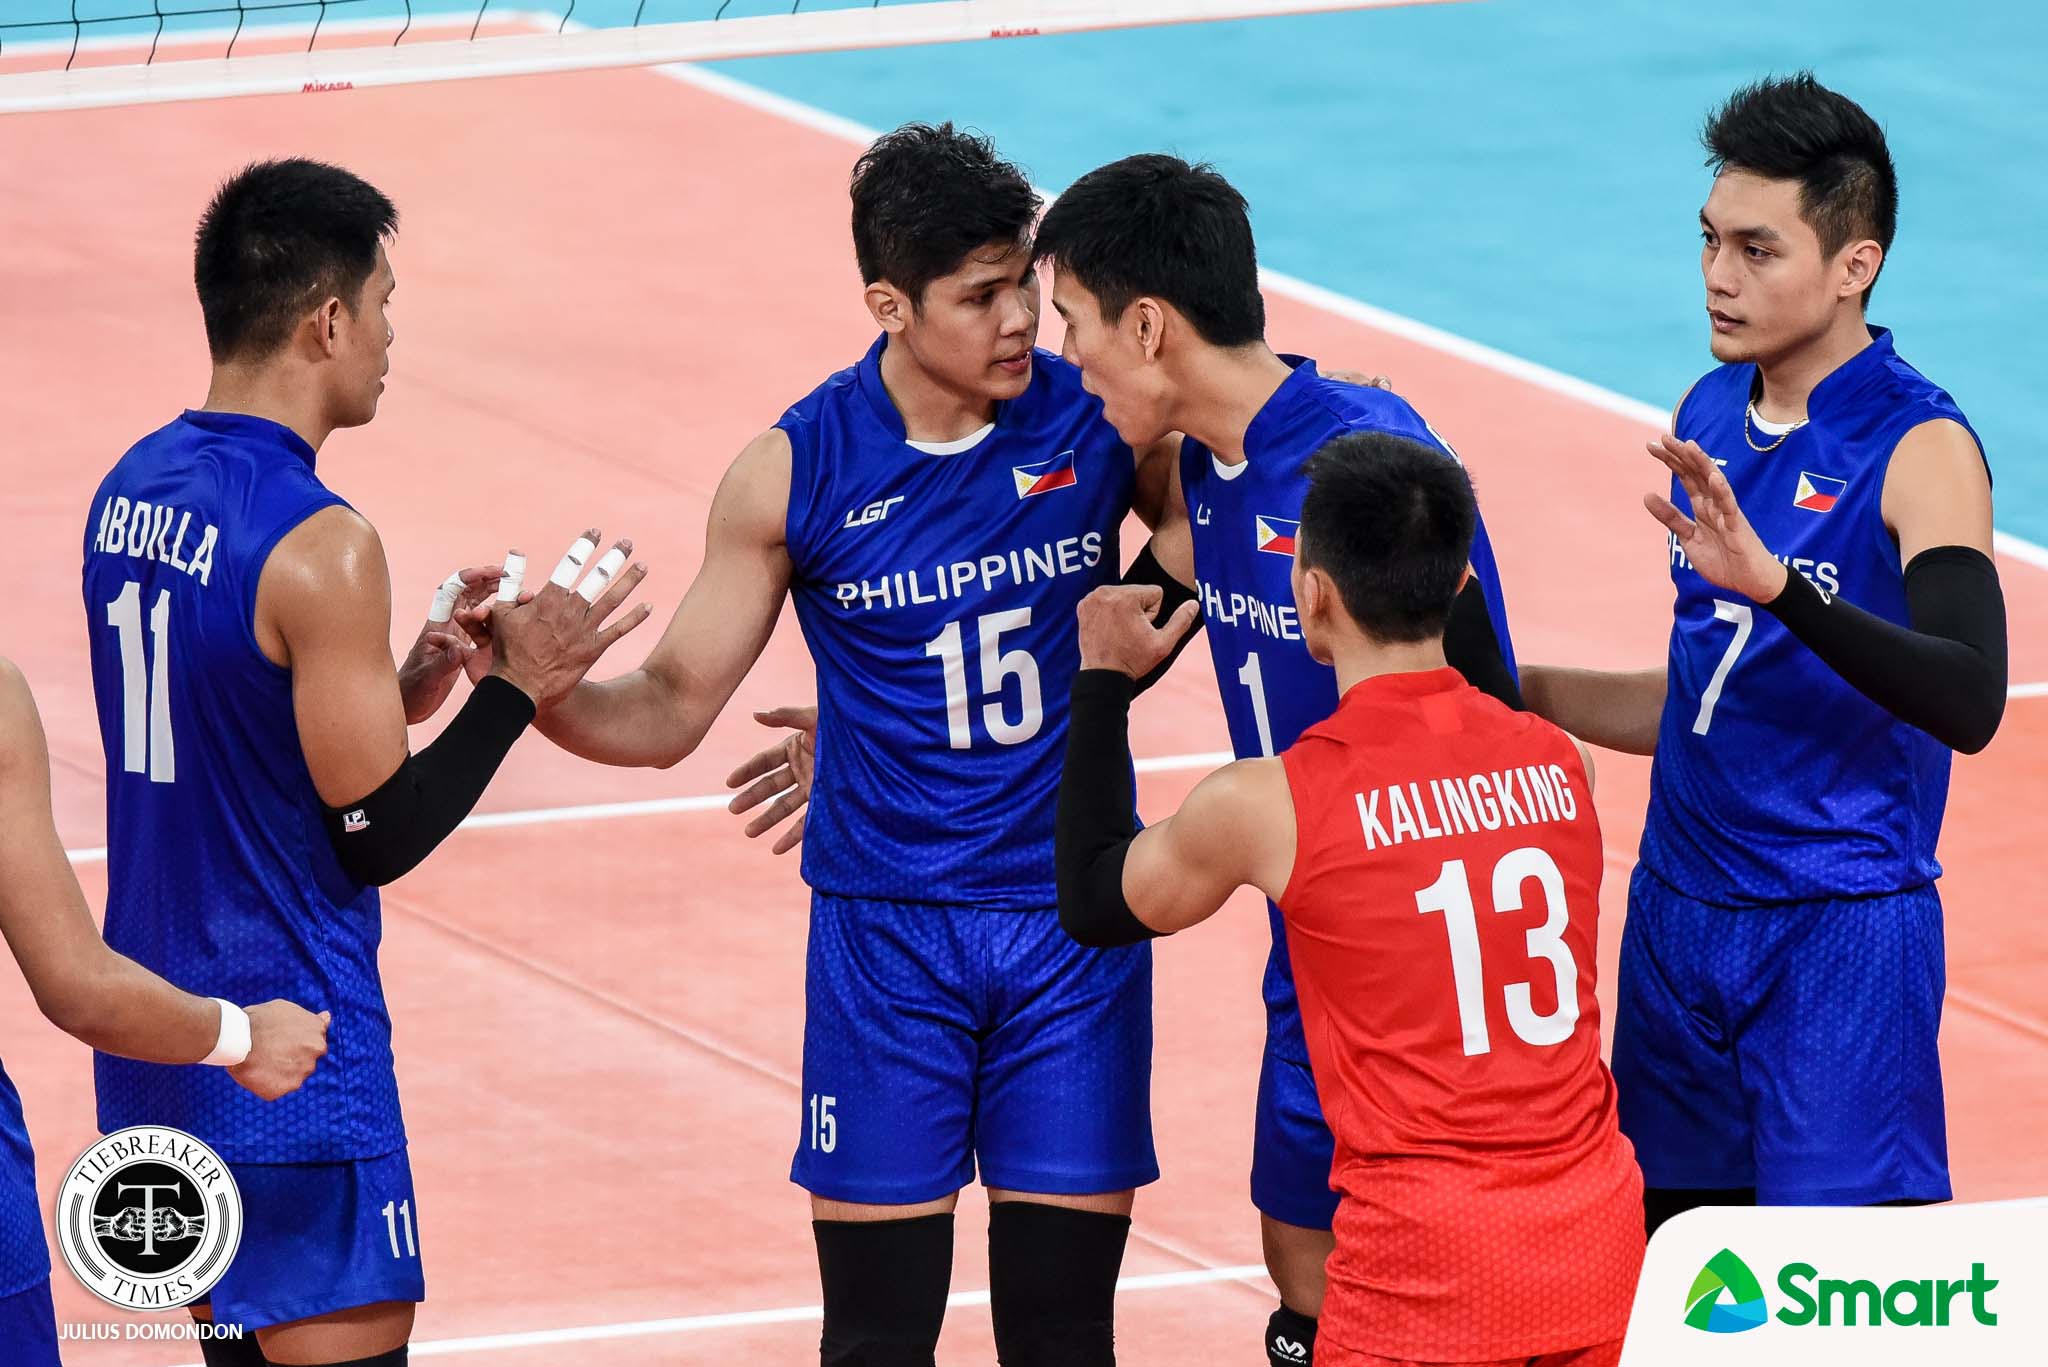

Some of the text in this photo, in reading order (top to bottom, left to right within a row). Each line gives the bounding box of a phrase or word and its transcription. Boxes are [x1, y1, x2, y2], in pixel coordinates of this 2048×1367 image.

[94, 496, 219, 587] ABDILLA
[837, 531, 1102, 610] PHILIPPINES
[107, 581, 175, 783] 11
[926, 606, 1044, 749] 15
[1238, 652, 1275, 758] 1
[1692, 598, 1753, 736] 7
[1355, 764, 1577, 850] KALINGKING
[1415, 847, 1581, 1057] 13
[810, 1093, 837, 1154] 15
[382, 1199, 416, 1259] 11
